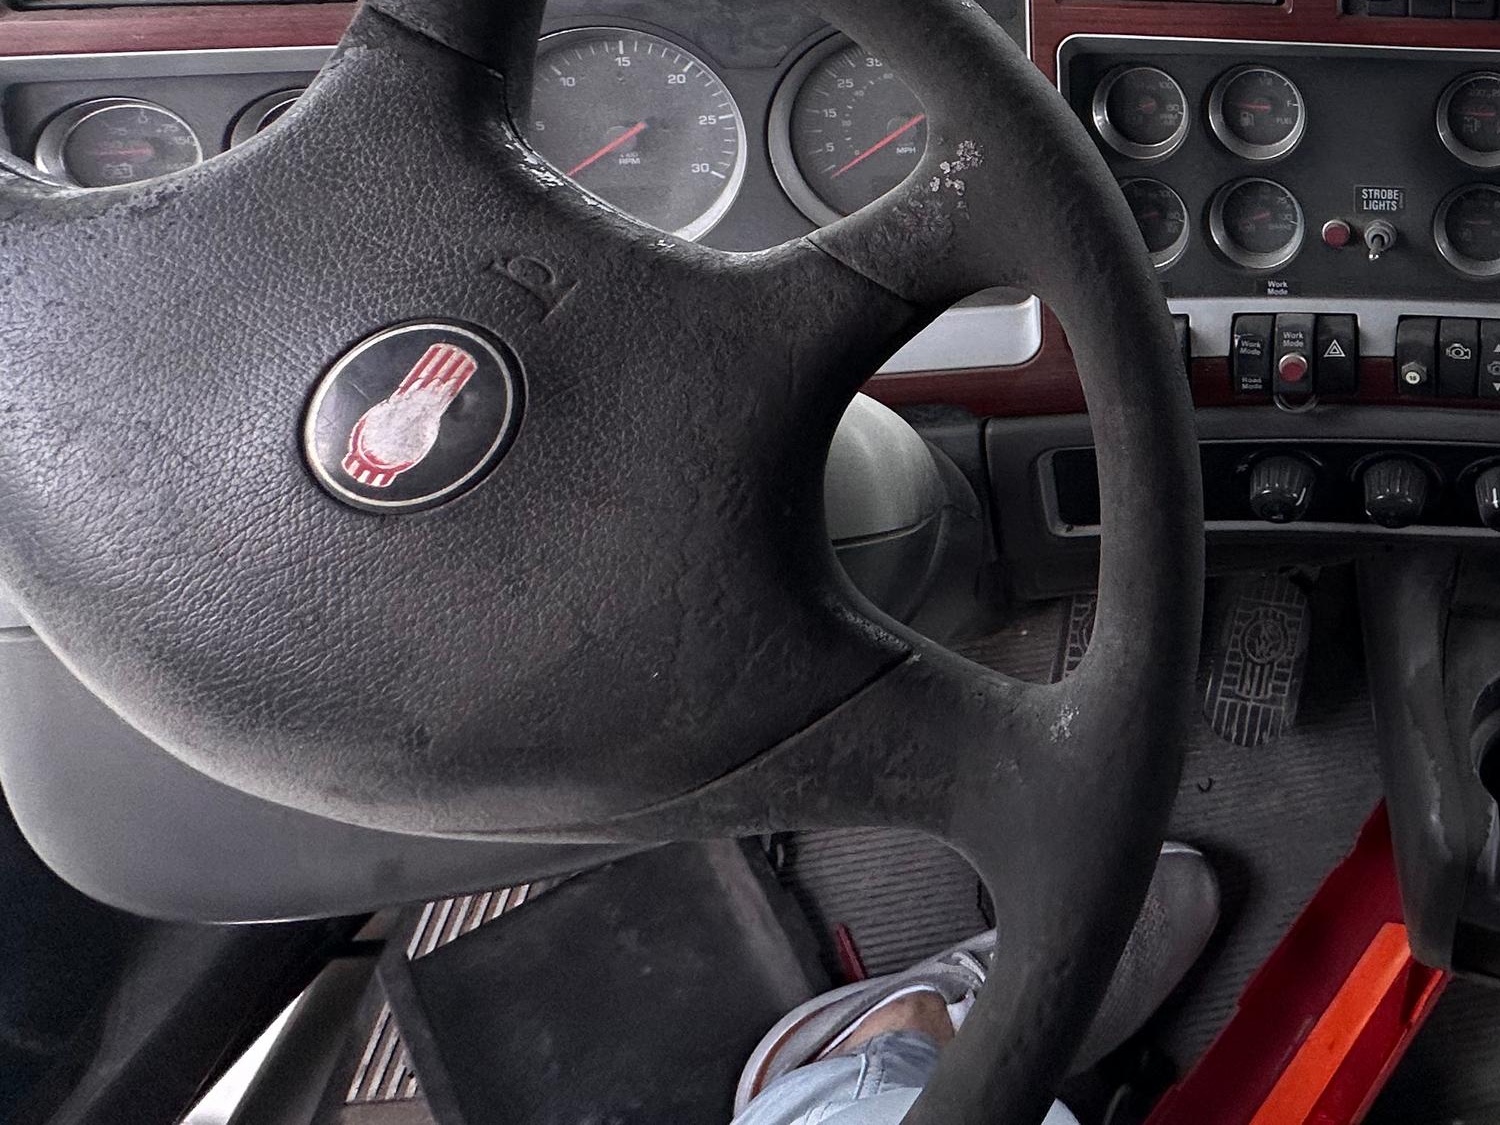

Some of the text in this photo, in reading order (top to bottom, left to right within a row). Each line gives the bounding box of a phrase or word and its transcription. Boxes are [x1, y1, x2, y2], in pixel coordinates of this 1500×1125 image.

[615, 57, 631, 66] 15
[560, 77, 575, 86] 10
[668, 74, 686, 84] 20
[837, 78, 854, 88] 25
[823, 108, 837, 118] 15
[699, 115, 716, 124] 25
[535, 121, 545, 130] 5
[826, 142, 834, 152] 5
[691, 164, 709, 173] 30
[1362, 188, 1399, 200] STROBE
[1363, 200, 1398, 211] LIGHTS
